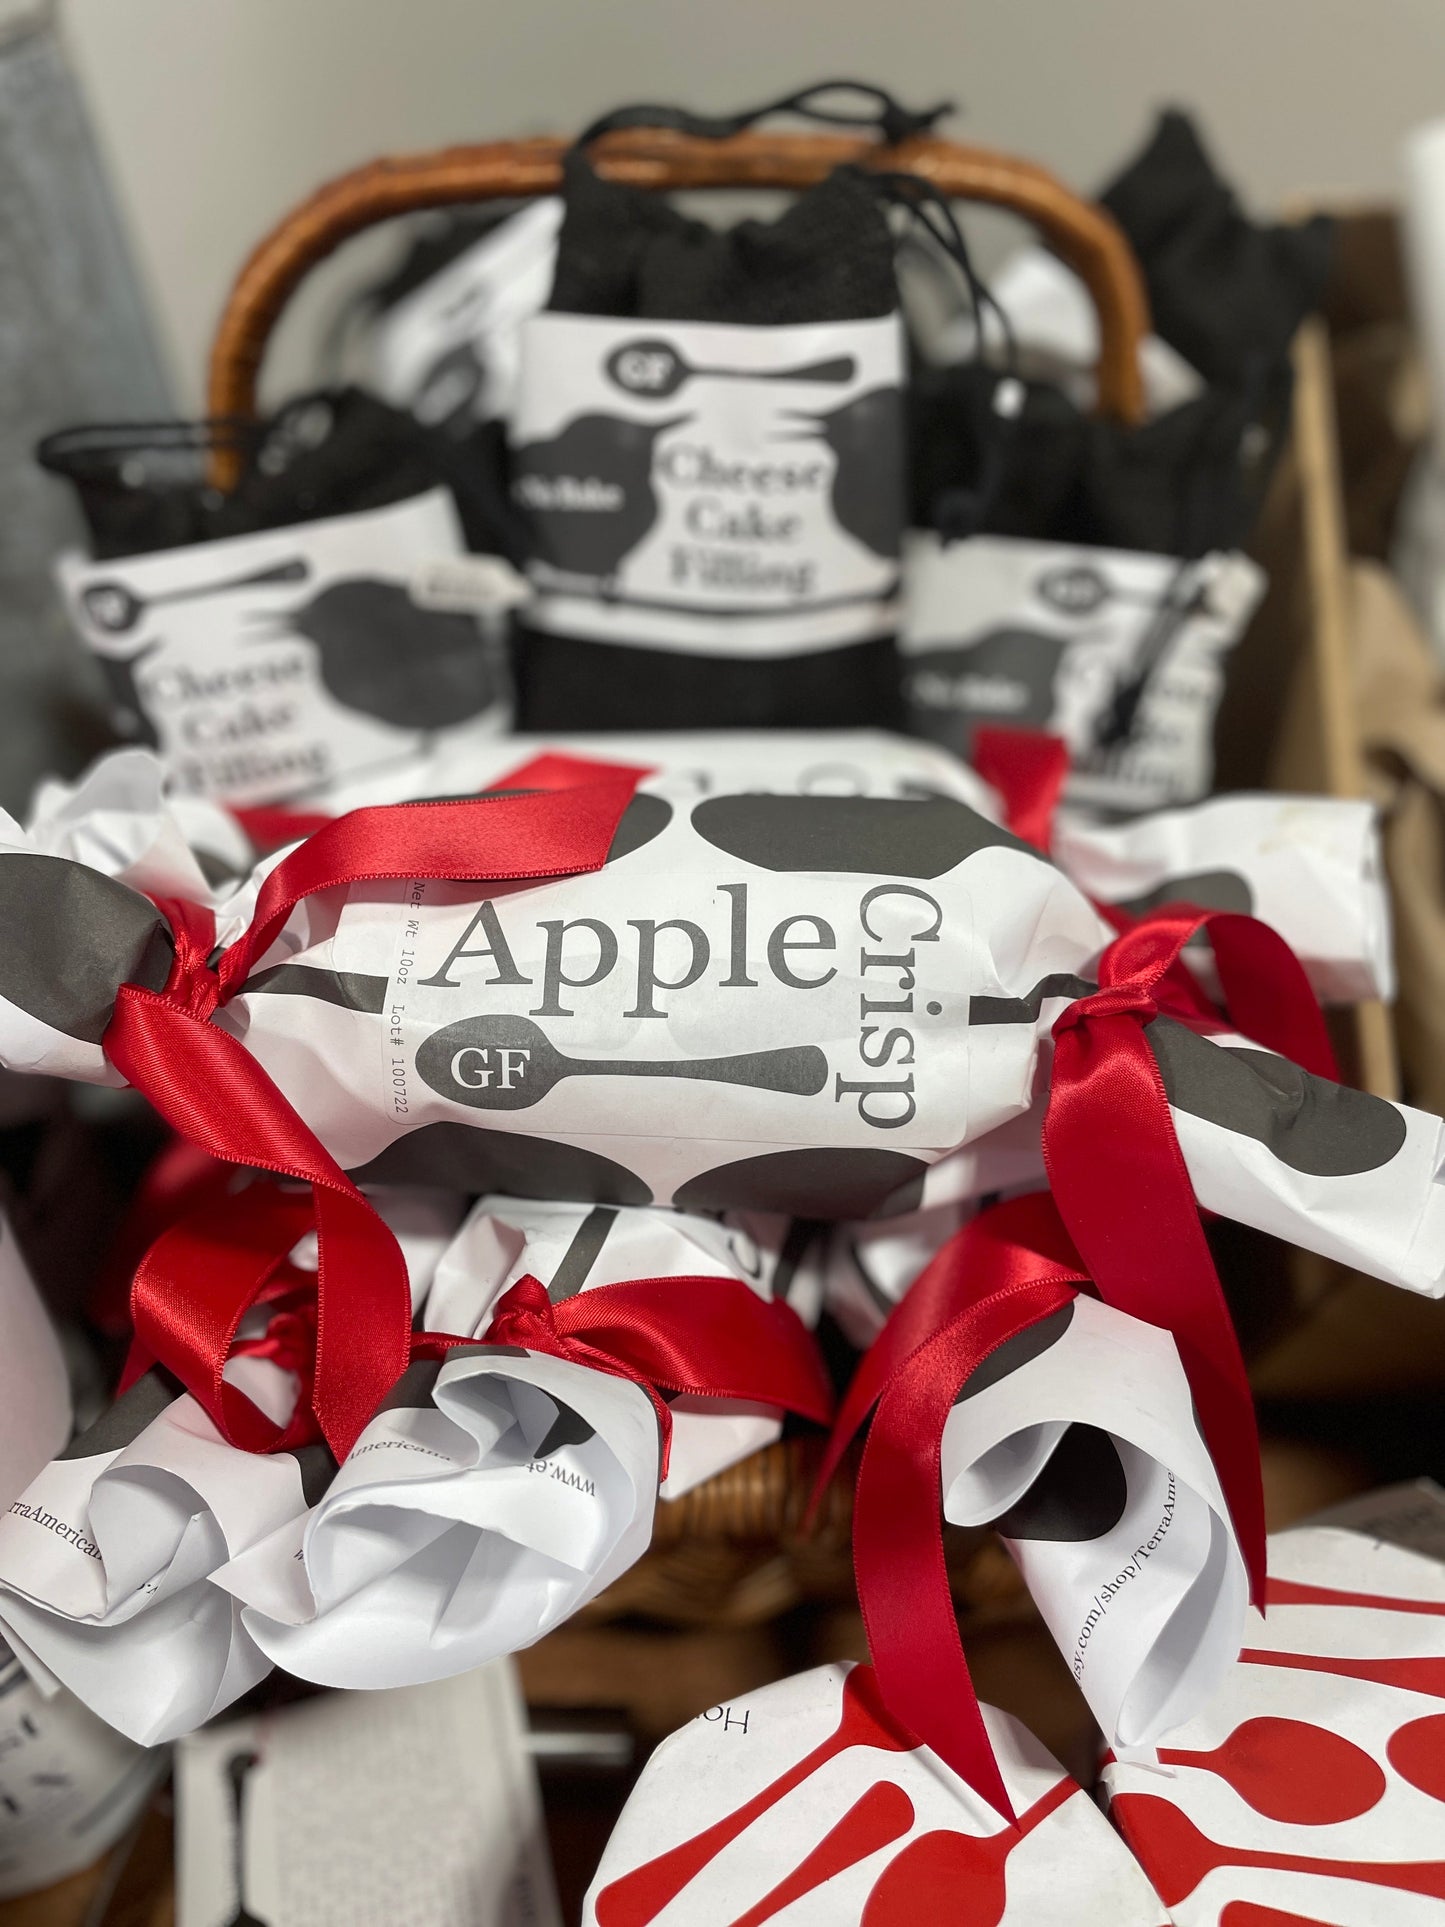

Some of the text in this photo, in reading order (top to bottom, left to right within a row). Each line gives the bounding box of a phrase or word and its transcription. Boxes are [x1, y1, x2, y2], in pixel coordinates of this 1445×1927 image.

[652, 441, 824, 494] Cheese
[683, 499, 798, 541] Cake
[667, 545, 816, 597] Filling
[143, 652, 306, 705] Cheese
[181, 699, 297, 744] Cake
[178, 740, 328, 797] Filling
[417, 882, 839, 1019] Apple
[390, 881, 426, 1114] Net Wt 10oz Lot# 100722
[835, 883, 943, 1130] Crisp
[450, 1047, 531, 1090] GF
[523, 1459, 596, 1497] www.et
[1073, 1469, 1176, 1683] tsy.com/shop/TerraAme
[696, 1705, 750, 1734] Ho
